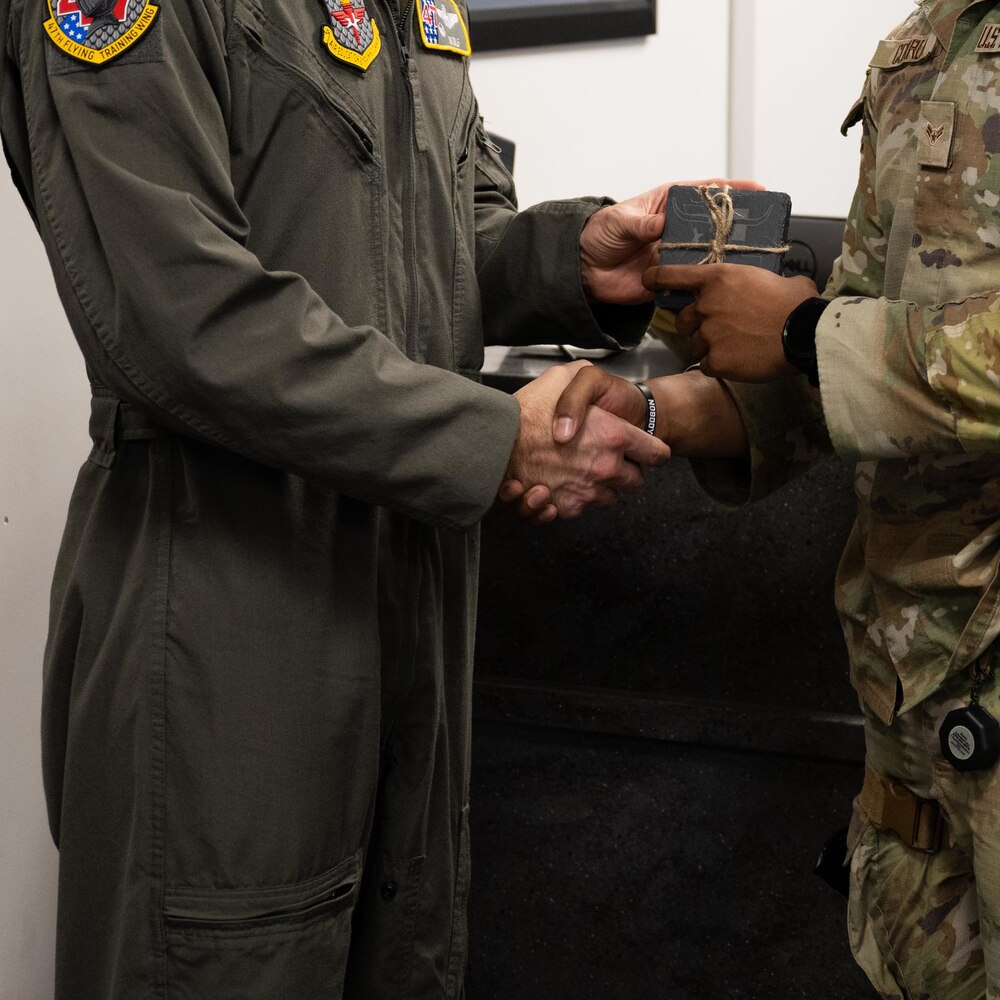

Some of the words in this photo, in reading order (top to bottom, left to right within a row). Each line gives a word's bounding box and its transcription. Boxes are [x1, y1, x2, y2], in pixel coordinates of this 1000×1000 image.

[48, 22, 64, 44] 47TH
[63, 39, 95, 60] FLYING
[100, 30, 138, 60] TRAINING
[135, 7, 155, 31] WING
[647, 399, 656, 435] NOBODY
